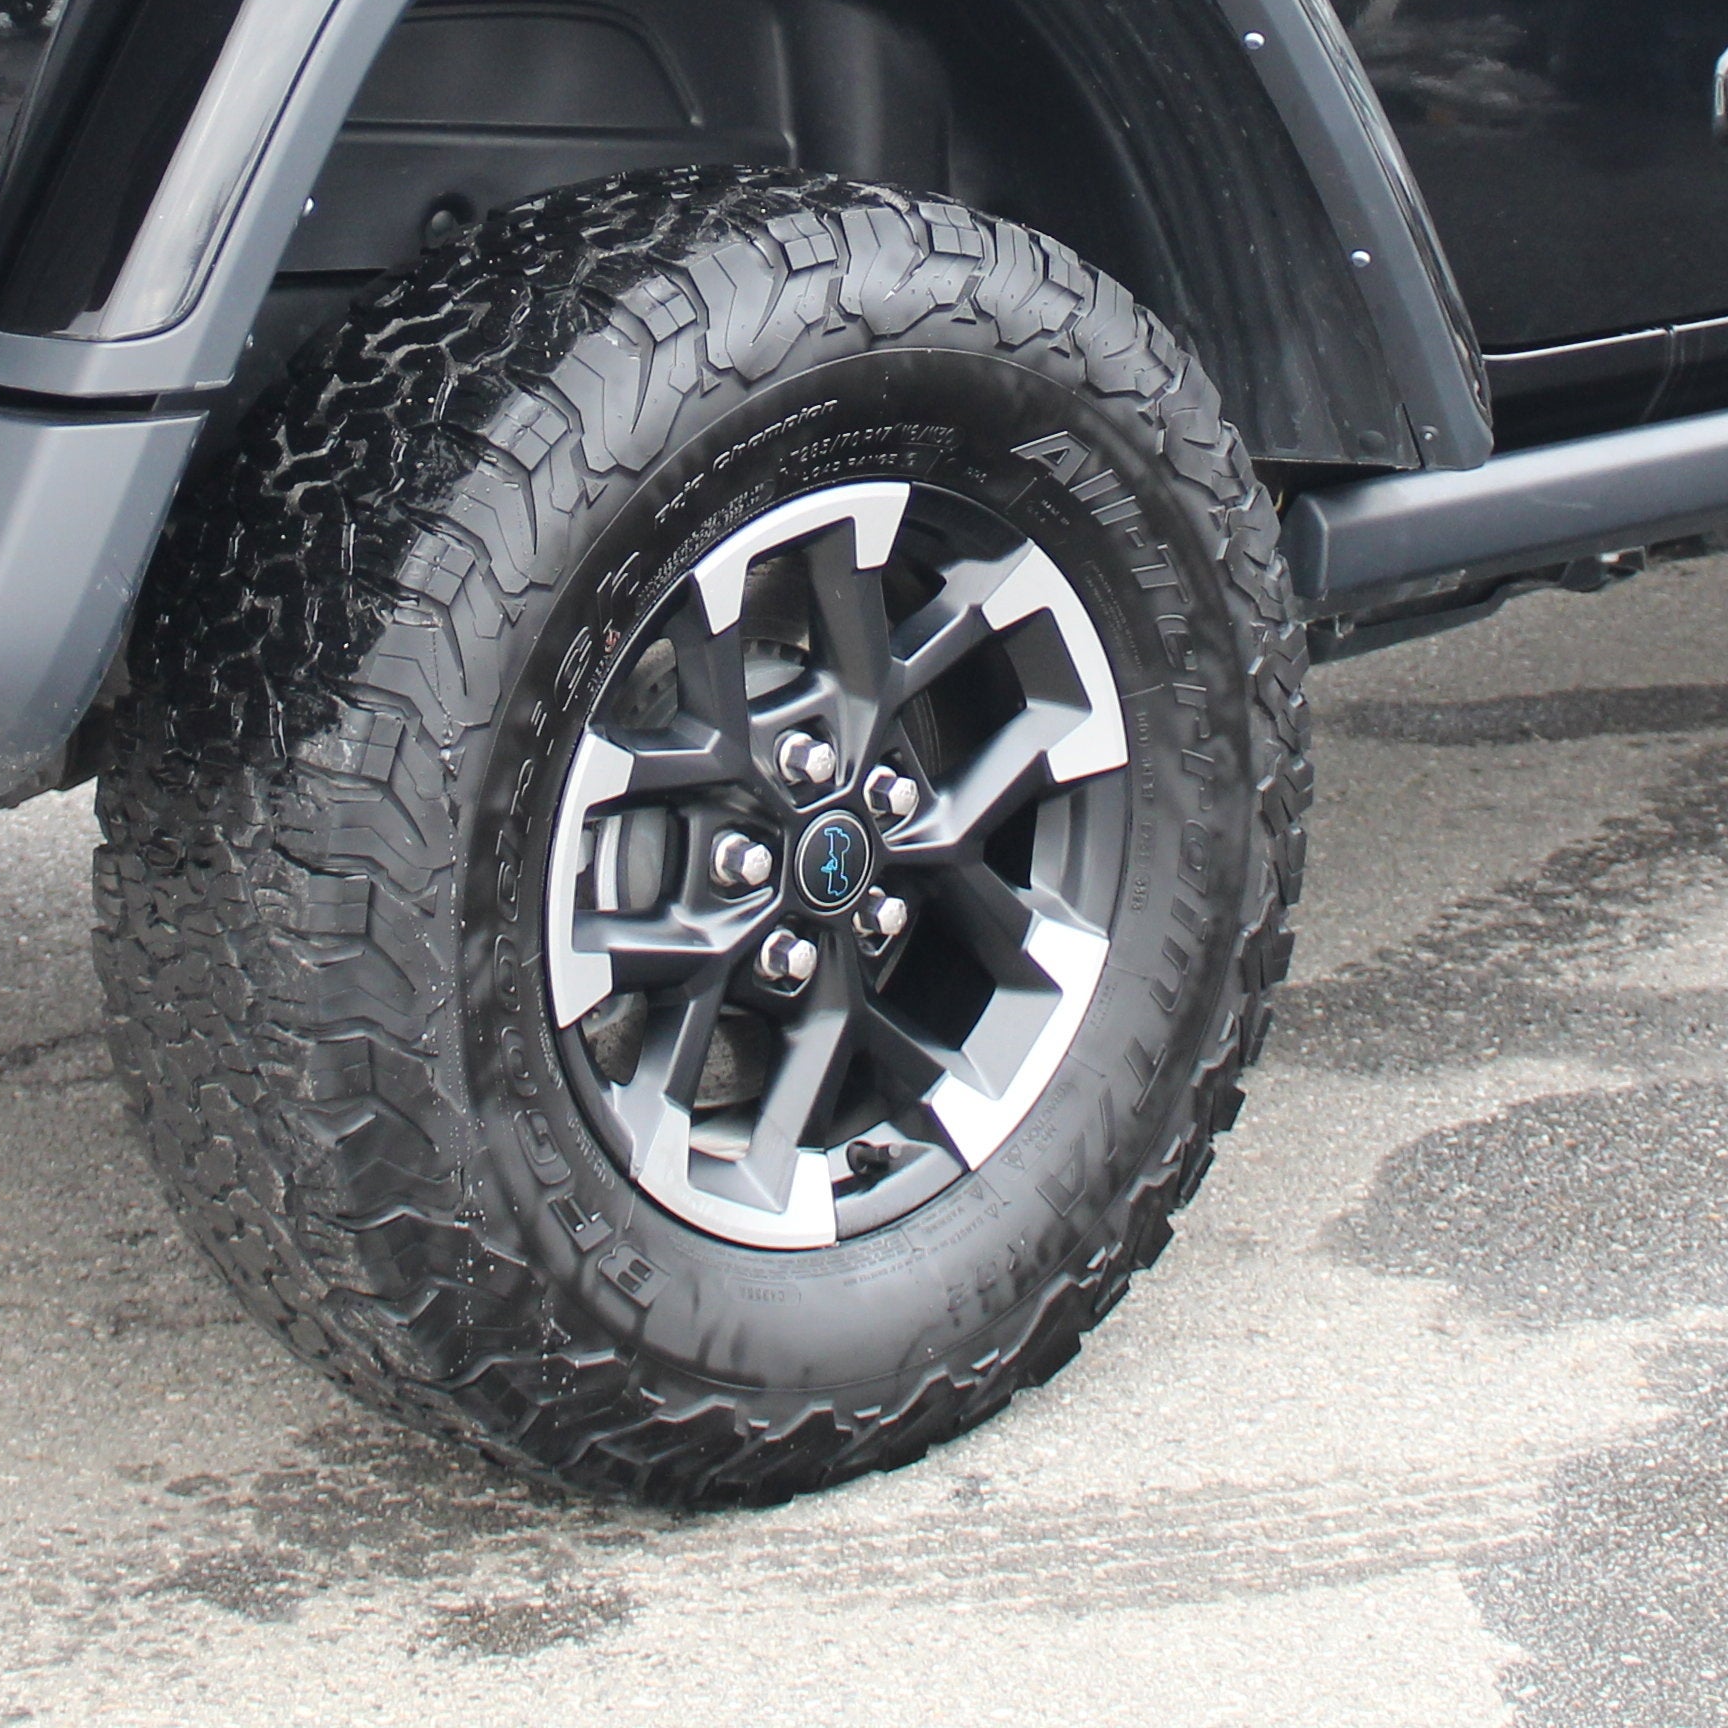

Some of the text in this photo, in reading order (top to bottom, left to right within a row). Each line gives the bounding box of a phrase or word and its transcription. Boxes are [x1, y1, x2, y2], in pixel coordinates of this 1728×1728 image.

[712, 398, 839, 473] Champion
[1009, 430, 1214, 1016] All-Terrain
[492, 550, 672, 1309] BFGoodrich
